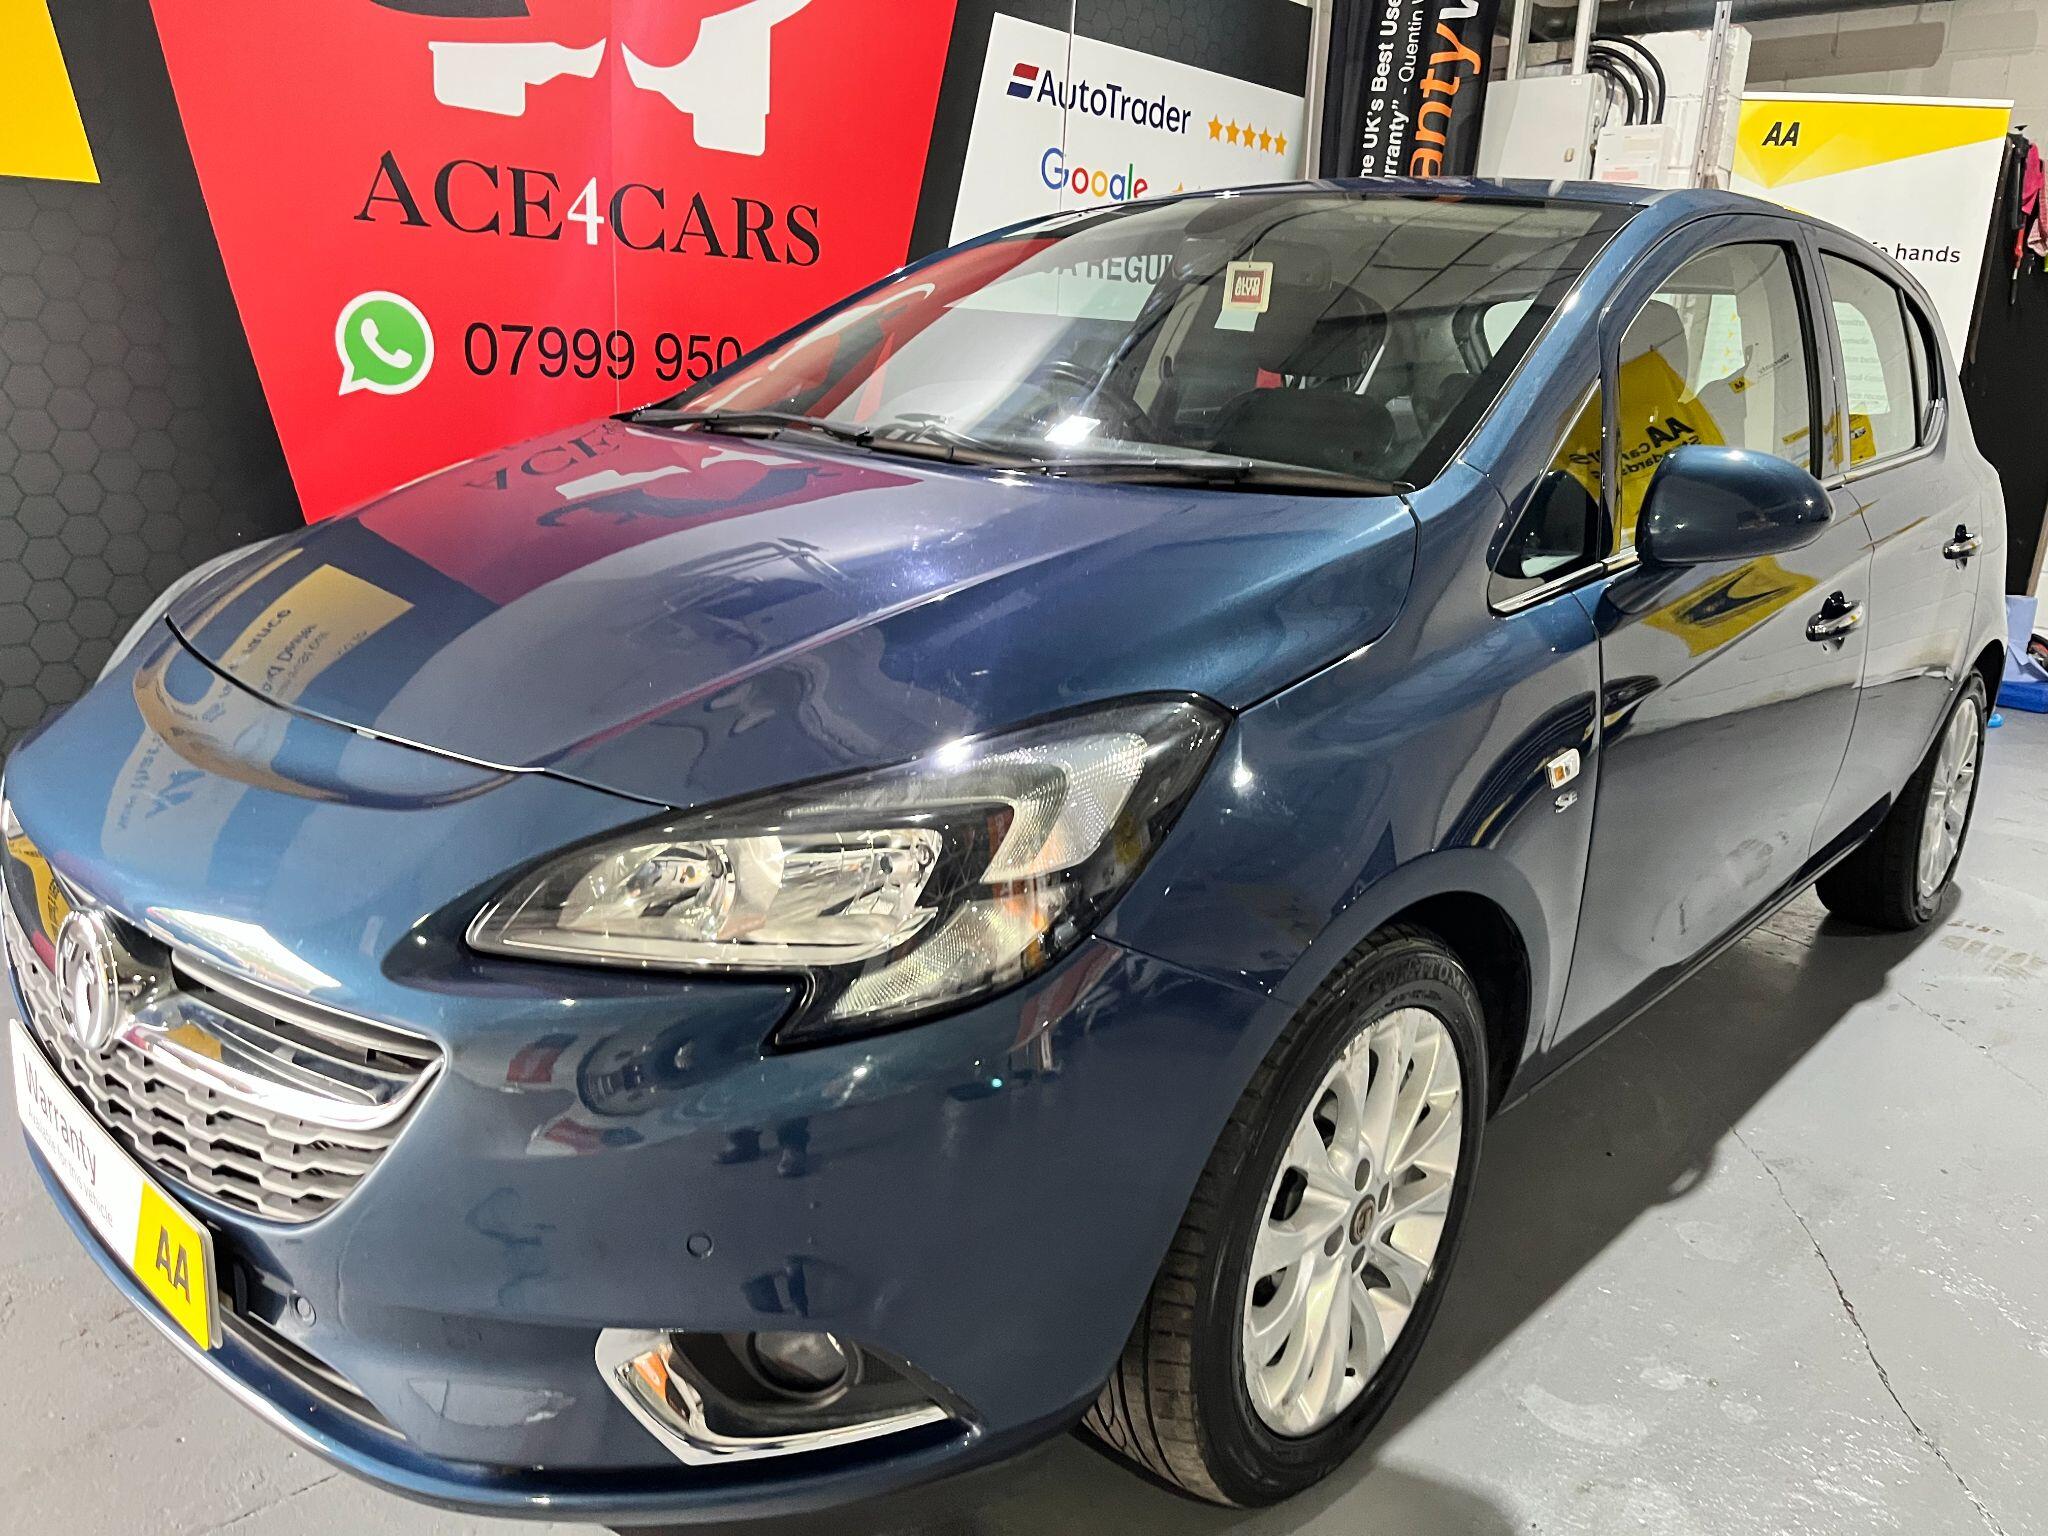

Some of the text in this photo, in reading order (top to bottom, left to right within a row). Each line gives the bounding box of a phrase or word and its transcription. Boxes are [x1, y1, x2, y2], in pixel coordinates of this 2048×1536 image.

[1370, 42, 1395, 92] Best
[1398, 10, 1424, 82] Quentin
[1037, 70, 1192, 134] AutoTrader
[1362, 98, 1385, 149] UK's
[1762, 121, 1801, 147] AA
[1041, 147, 1148, 201] Google
[354, 149, 820, 267] ACE4CARS
[1895, 243, 1961, 263] hands
[464, 322, 636, 382] 07999
[23, 1052, 97, 1186] Warranty
[83, 1184, 114, 1228] vehicle
[155, 1225, 191, 1305] AA
